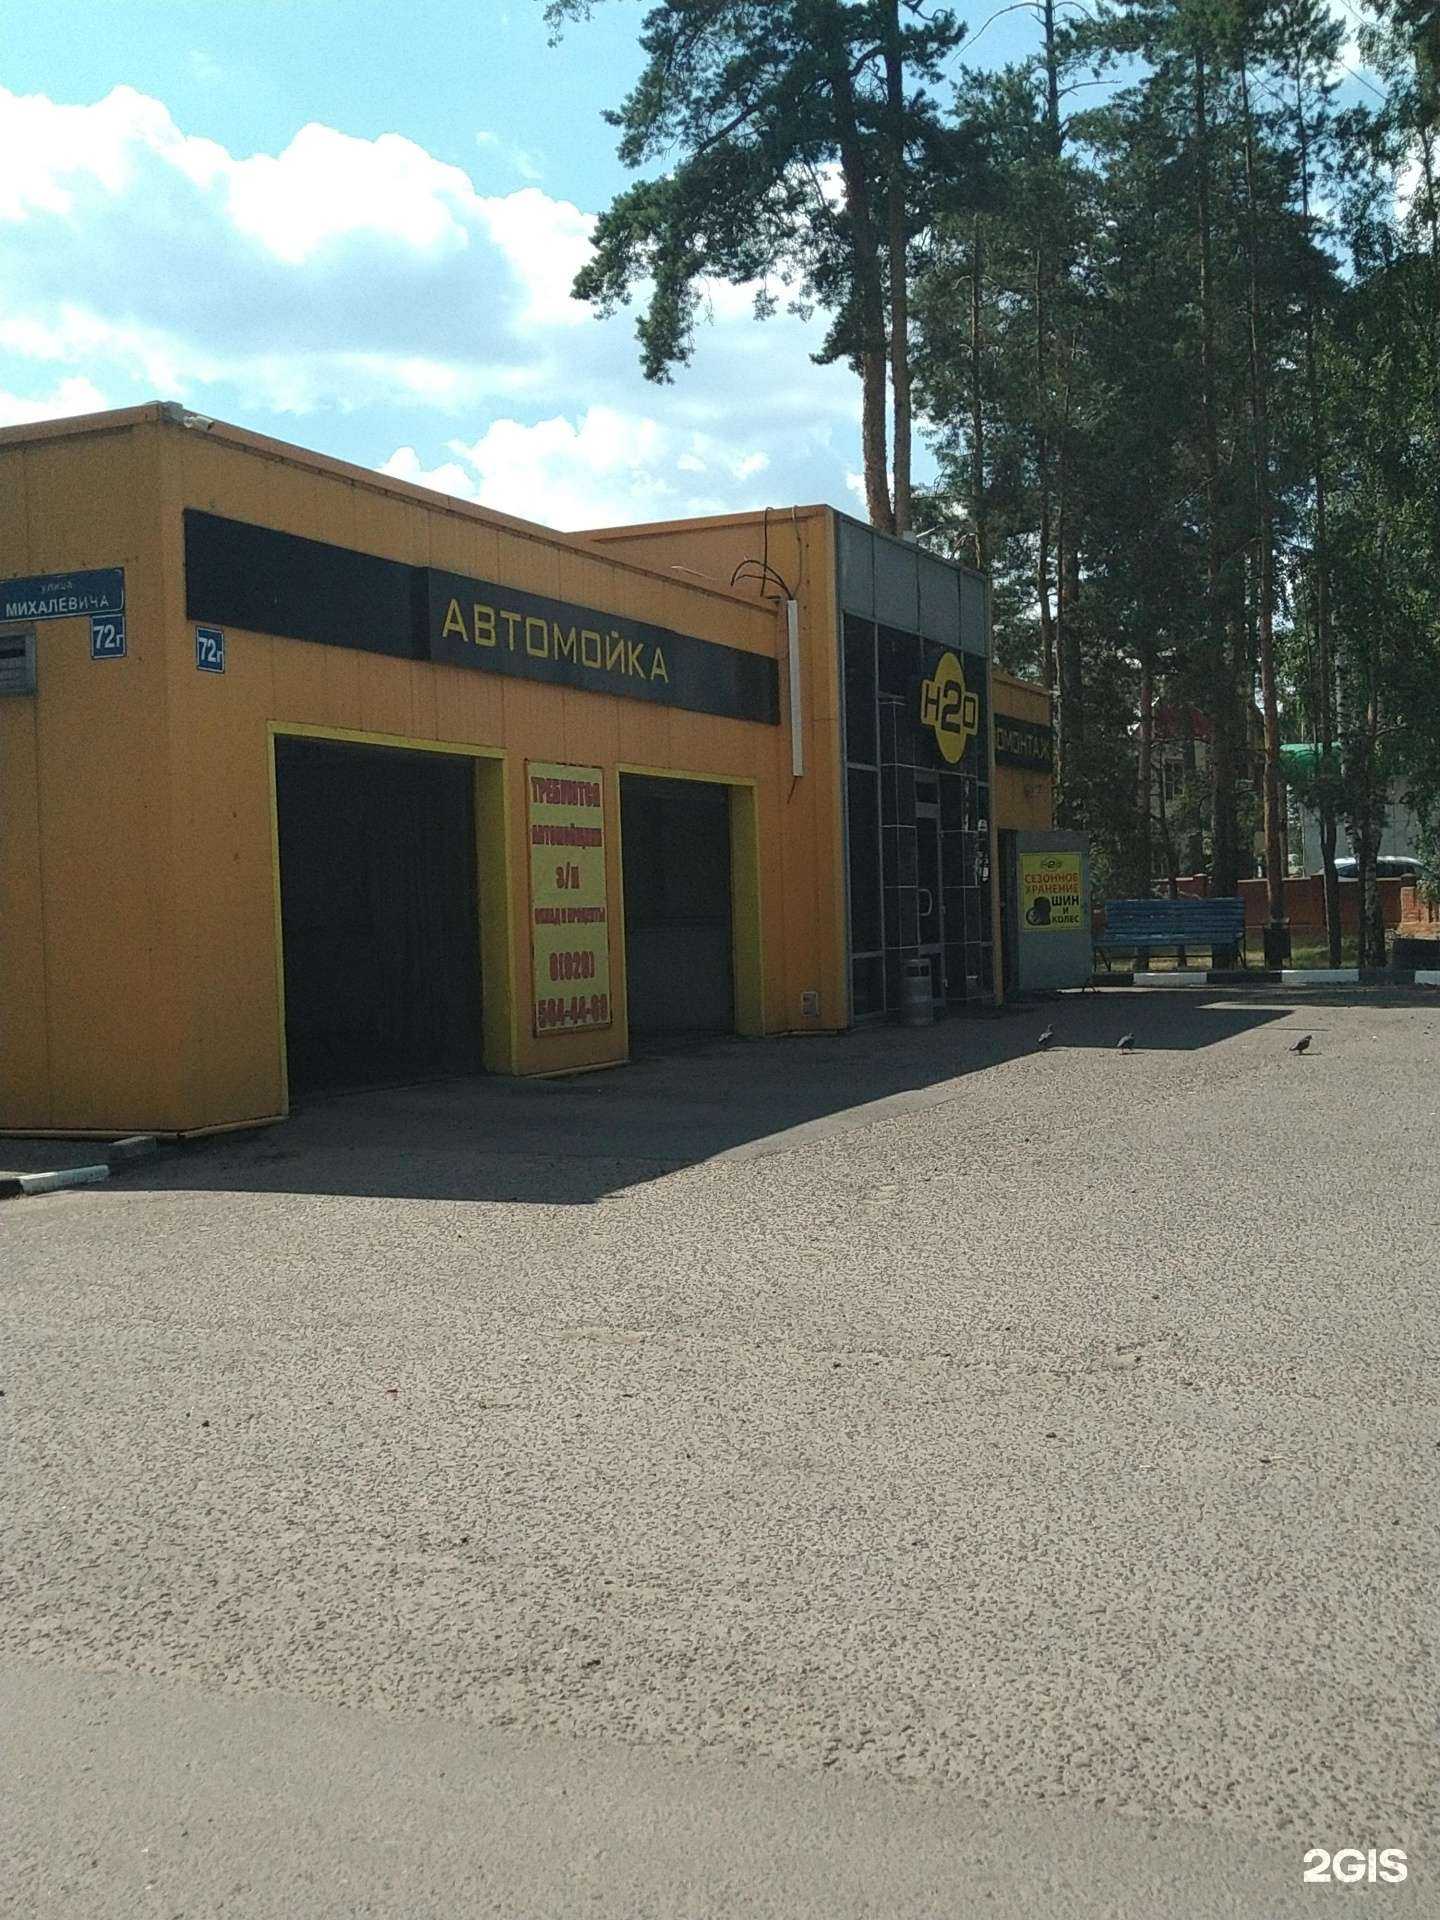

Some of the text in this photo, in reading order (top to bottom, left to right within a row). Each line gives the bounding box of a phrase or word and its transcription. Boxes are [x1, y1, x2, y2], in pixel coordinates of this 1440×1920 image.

[6, 594, 110, 617] МИХАЛЕВИЧА
[442, 598, 669, 683] АВТОМОЙКА
[1025, 873, 1079, 883] СЕЗОННОЕ
[1024, 883, 1079, 895] ХРАНЕНИЕ
[1051, 896, 1079, 906] ШИН
[1051, 915, 1080, 923] КОЛЕС
